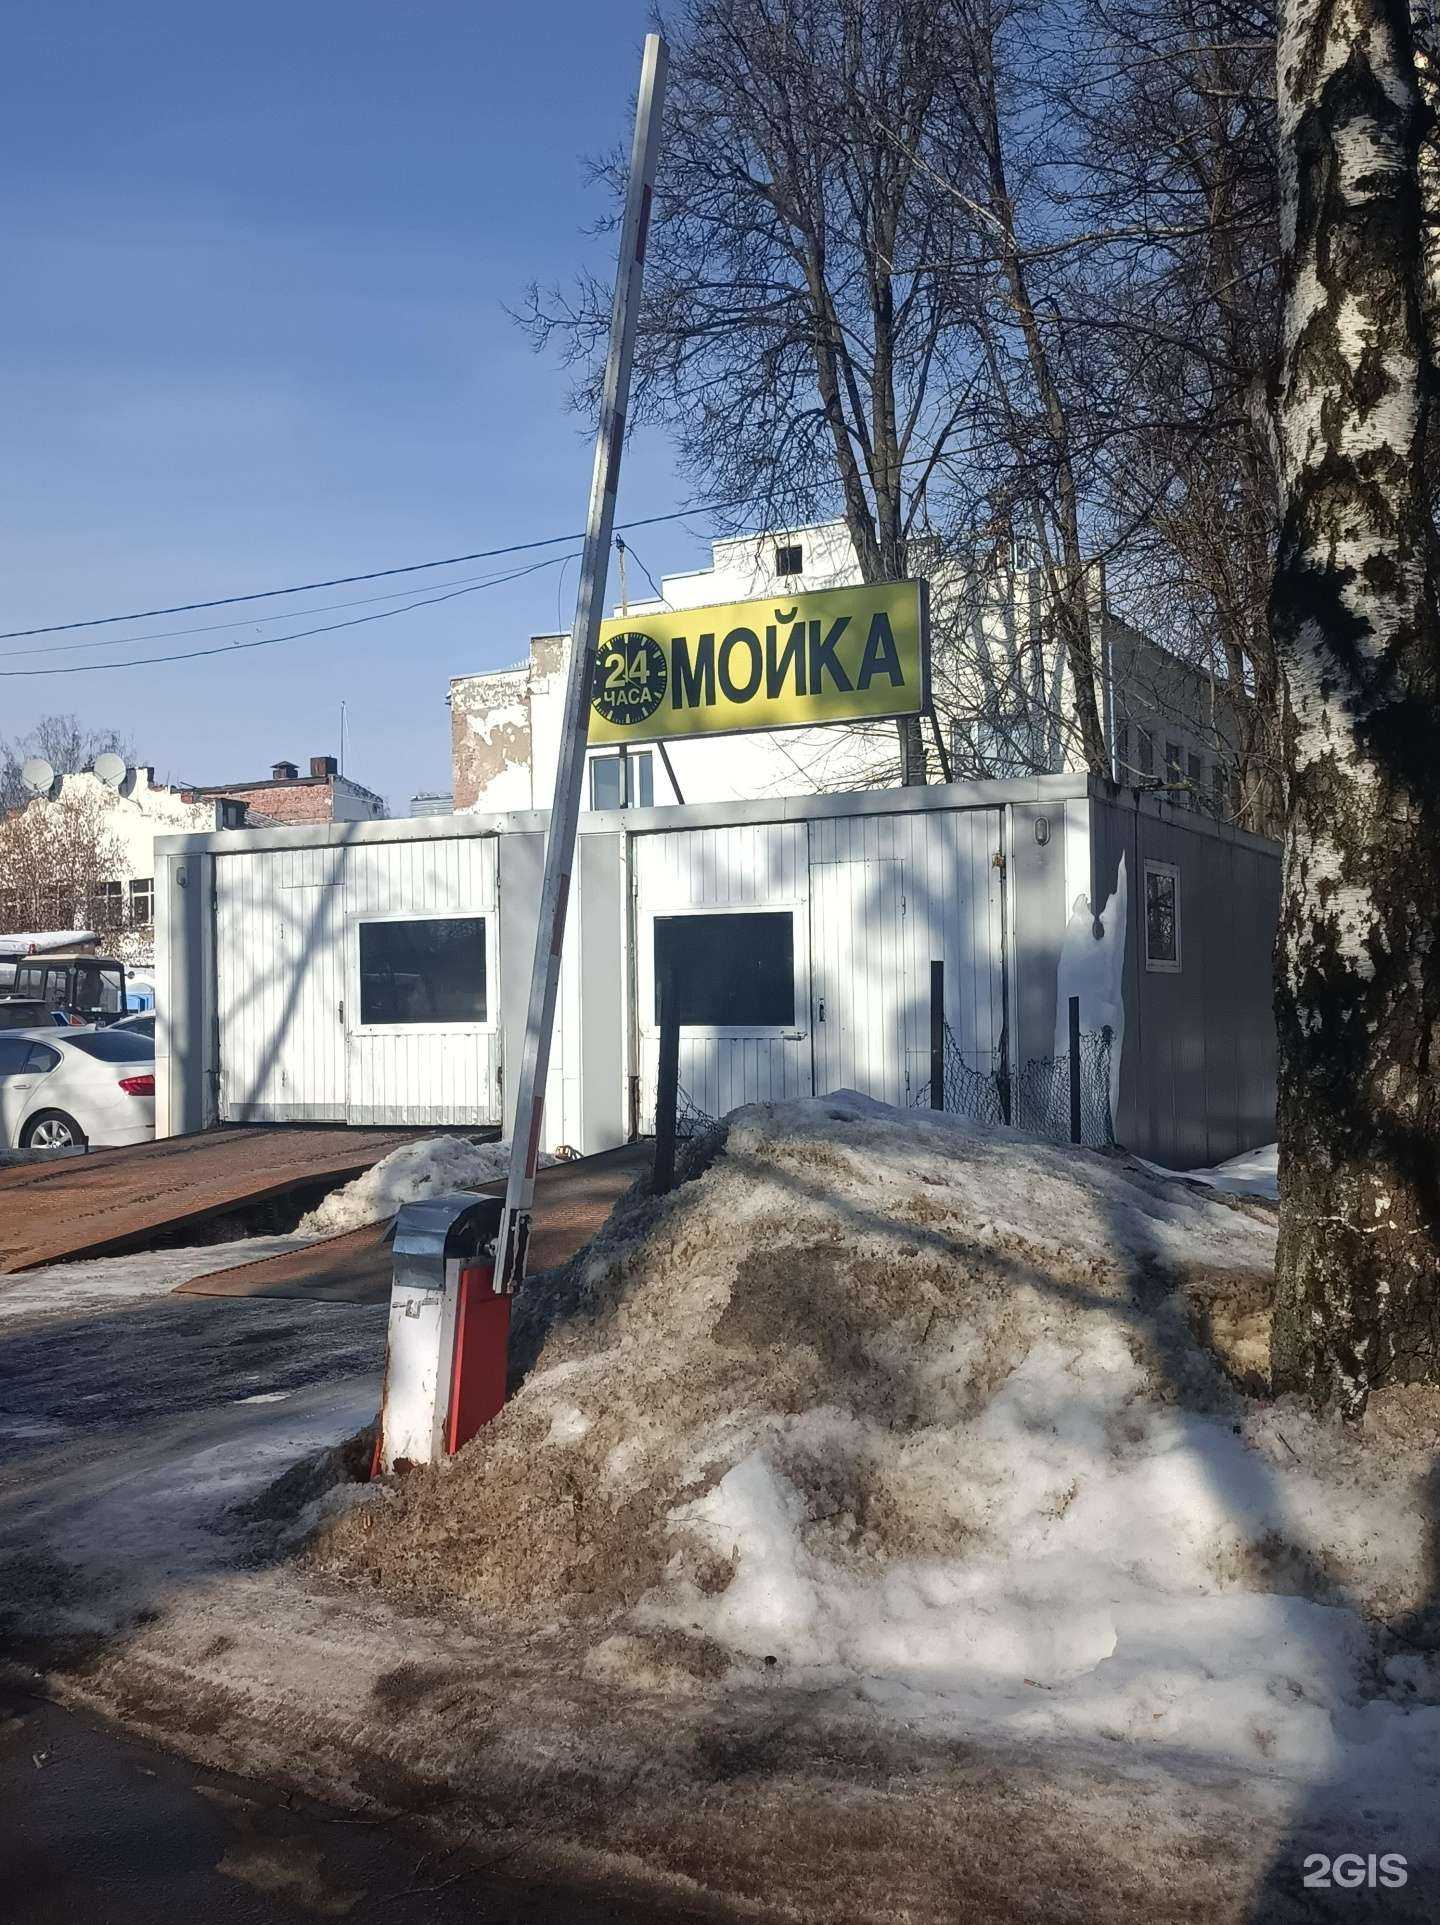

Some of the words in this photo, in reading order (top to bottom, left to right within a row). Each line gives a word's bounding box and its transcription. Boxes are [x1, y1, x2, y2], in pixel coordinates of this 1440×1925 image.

[604, 650, 650, 689] 24
[671, 607, 905, 709] МОЙКА
[603, 688, 652, 707] ЧАСА
